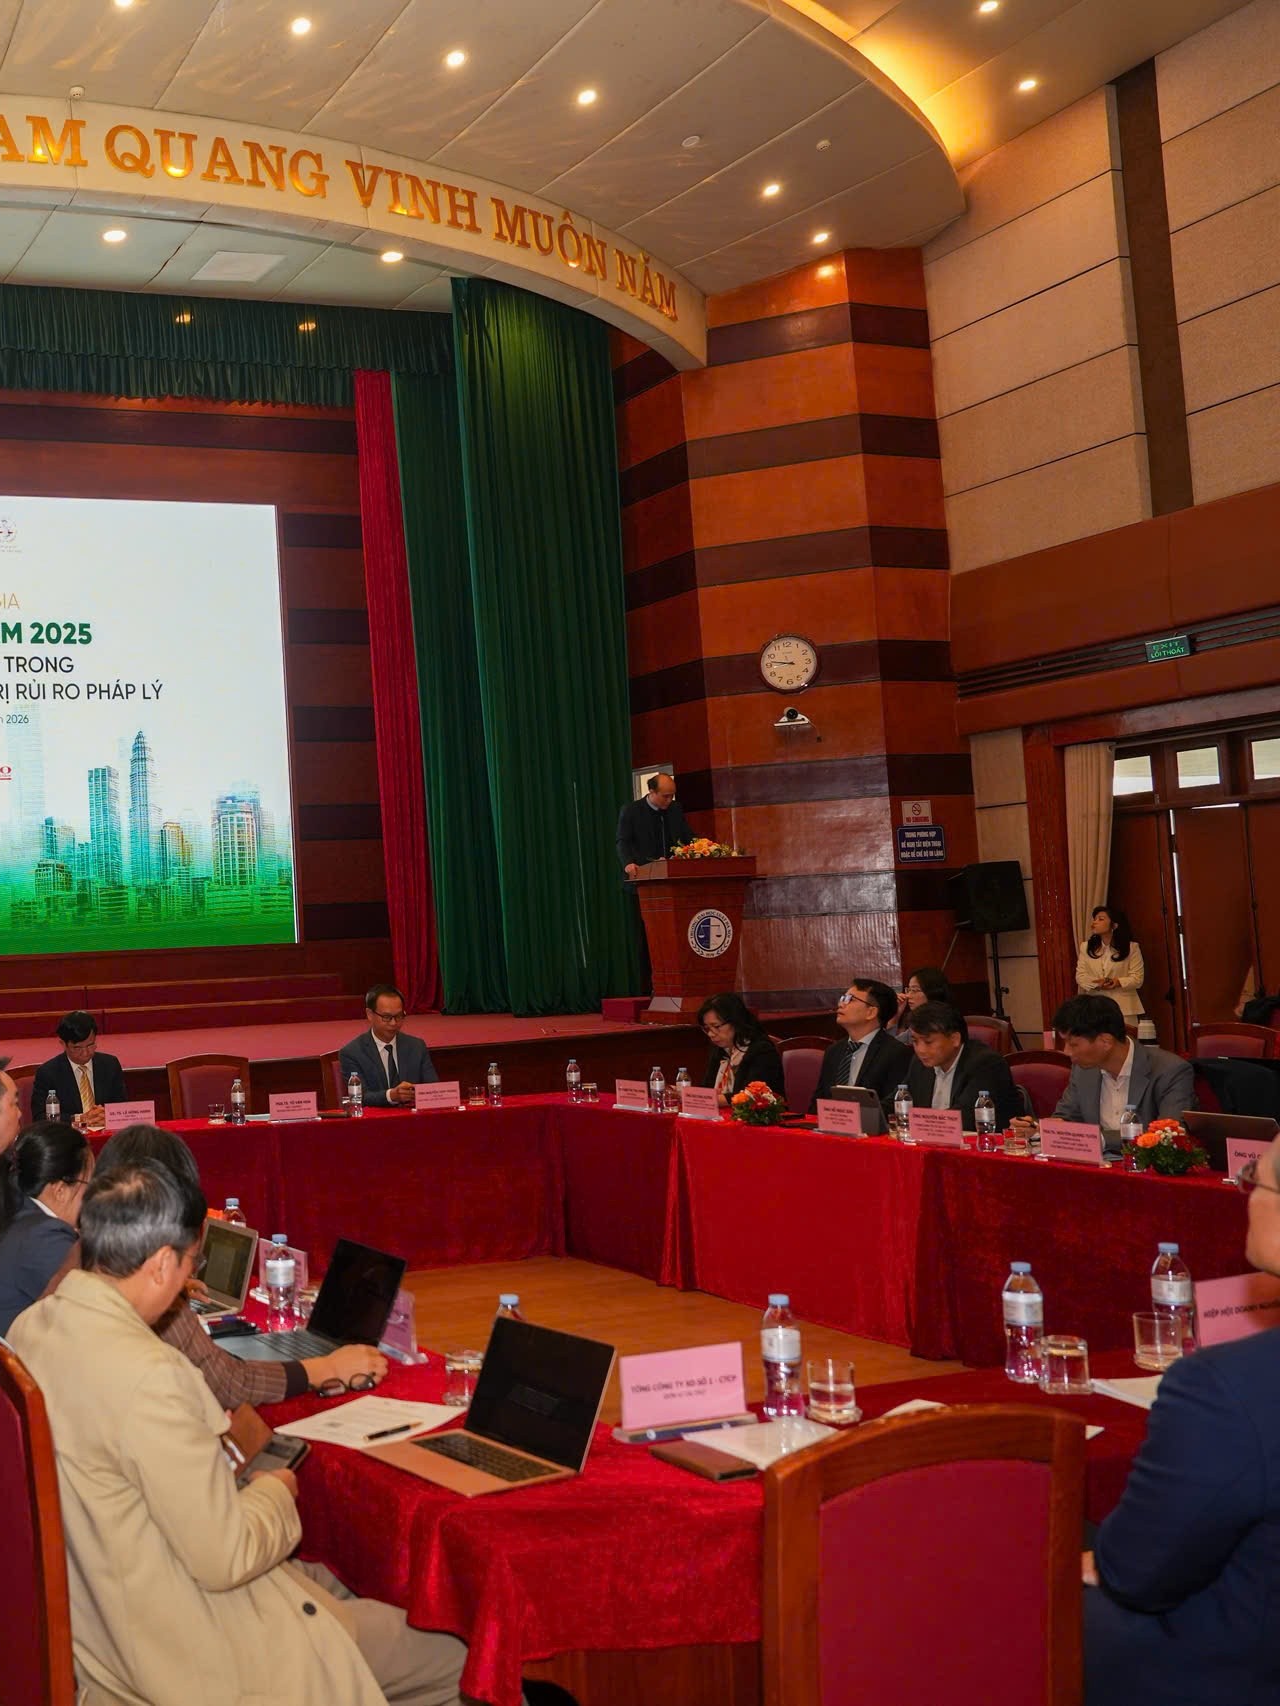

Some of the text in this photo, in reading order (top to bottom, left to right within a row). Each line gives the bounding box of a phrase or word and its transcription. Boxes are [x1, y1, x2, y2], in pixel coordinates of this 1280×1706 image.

[104, 124, 330, 198] QUANG
[345, 159, 482, 233] VINH
[490, 197, 608, 280] MUÔN
[613, 248, 679, 321] NĂM
[30, 621, 93, 645] 2025
[4, 656, 74, 673] TRONG
[16, 678, 46, 700] RỦI
[52, 683, 80, 700] RO
[86, 679, 136, 700] PHÁP
[142, 679, 163, 700] LÝ
[6, 714, 30, 725] 2026
